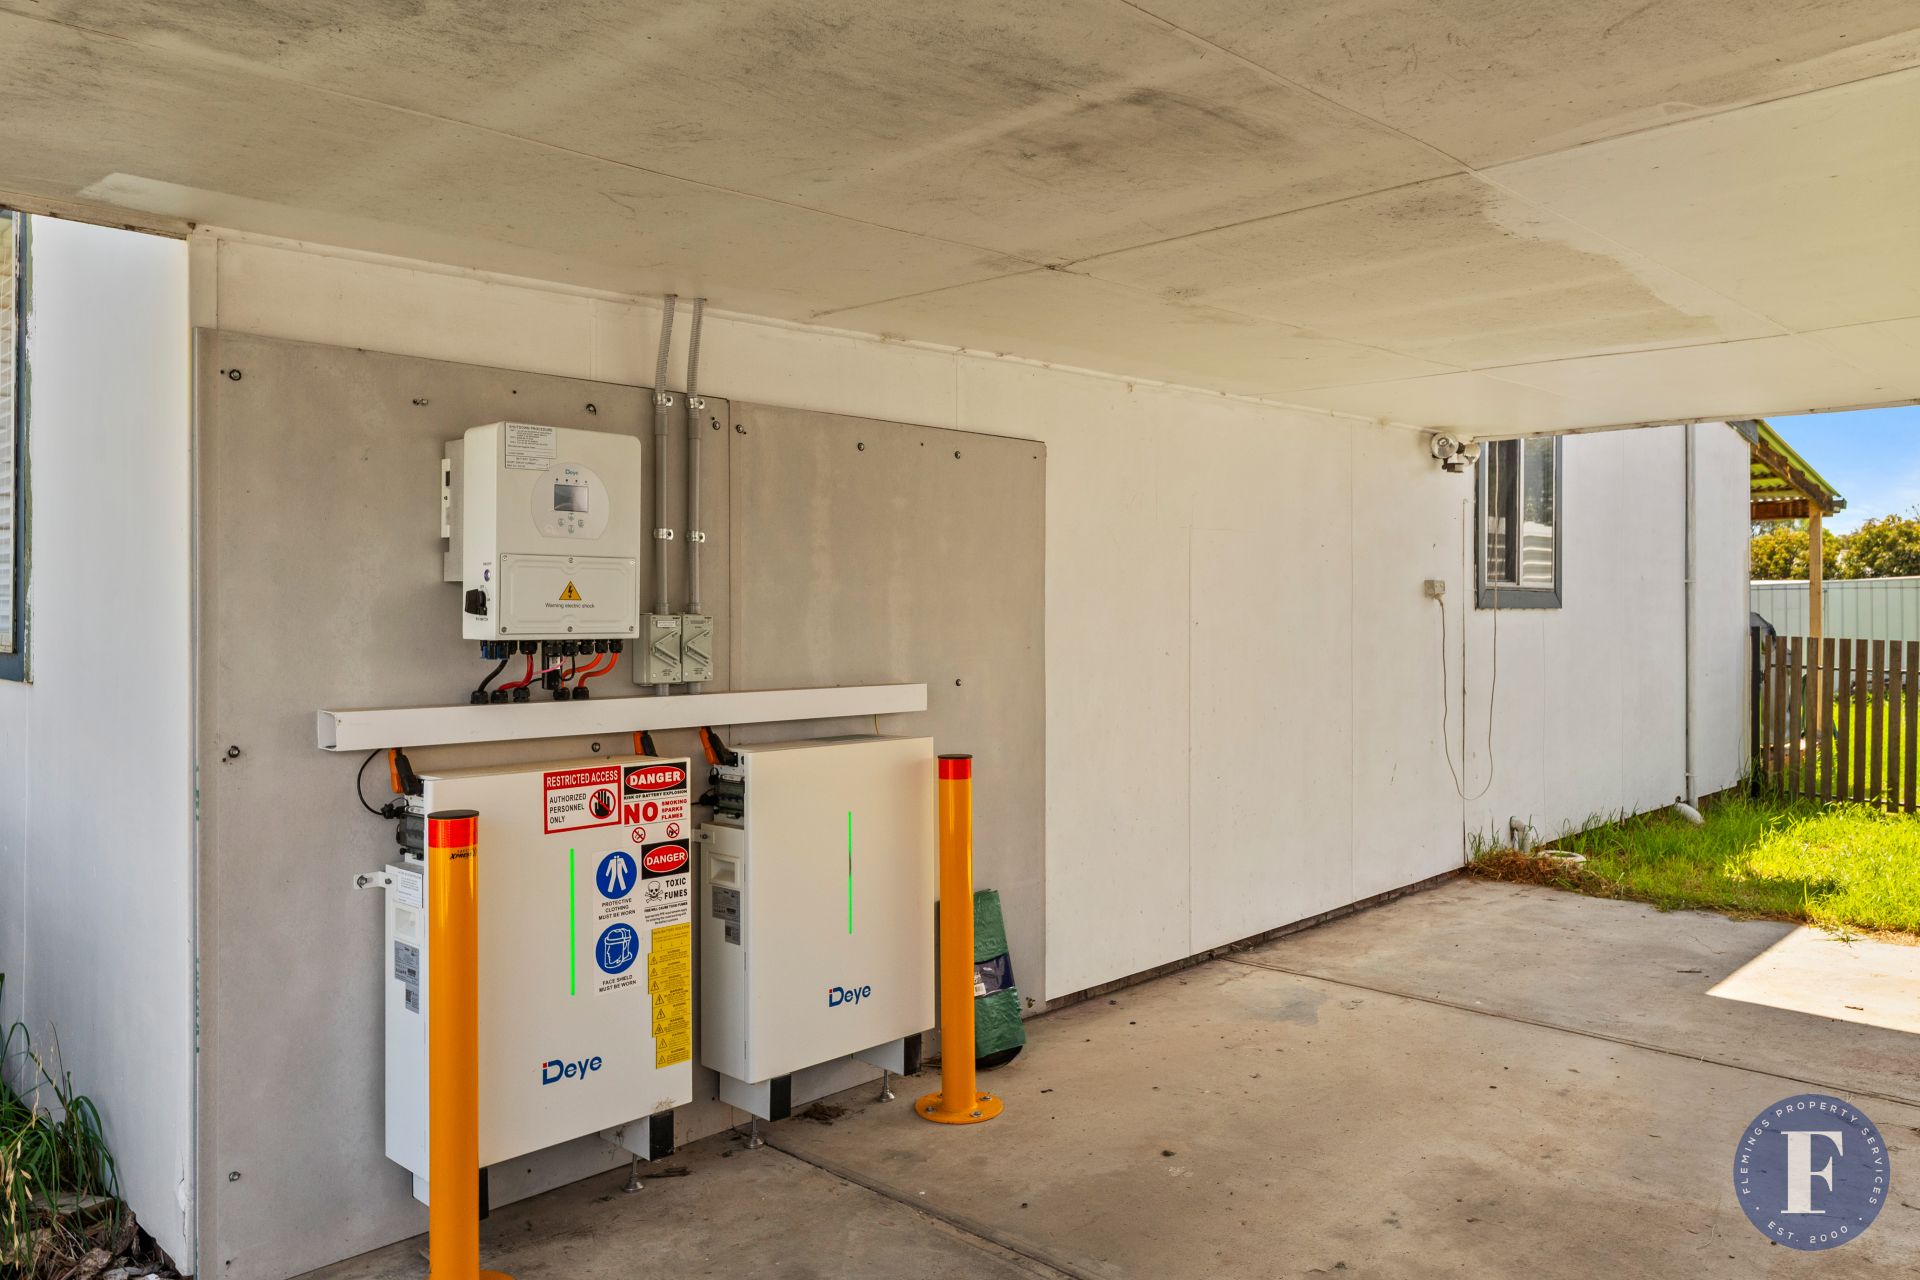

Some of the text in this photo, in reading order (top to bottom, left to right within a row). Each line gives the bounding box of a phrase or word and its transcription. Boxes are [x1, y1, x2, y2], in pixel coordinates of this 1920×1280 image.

[545, 602, 564, 610] Warning
[546, 769, 619, 788] RESTRICTED ACCESS
[629, 770, 681, 786] DANGER
[549, 792, 587, 804] AUTHORIZED
[661, 798, 688, 807] SMOKING
[549, 803, 585, 814] PERSONNEL
[624, 801, 659, 825] NO
[661, 805, 683, 813] SPARKS
[549, 815, 565, 824] ONLY
[661, 812, 683, 821] FLAMES
[646, 851, 686, 867] DANGER
[665, 877, 687, 888] TOXIC
[664, 888, 688, 900] FUMES
[601, 897, 632, 908] PROTECTIVE
[598, 913, 612, 921] MUST
[620, 909, 636, 918] WORN
[605, 905, 629, 913] CLOTHING
[602, 974, 633, 986] FACE SHIELD
[599, 984, 613, 993] MUST
[620, 980, 637, 989] WORN
[828, 983, 871, 1008] Deye
[542, 1055, 603, 1086] Deye
